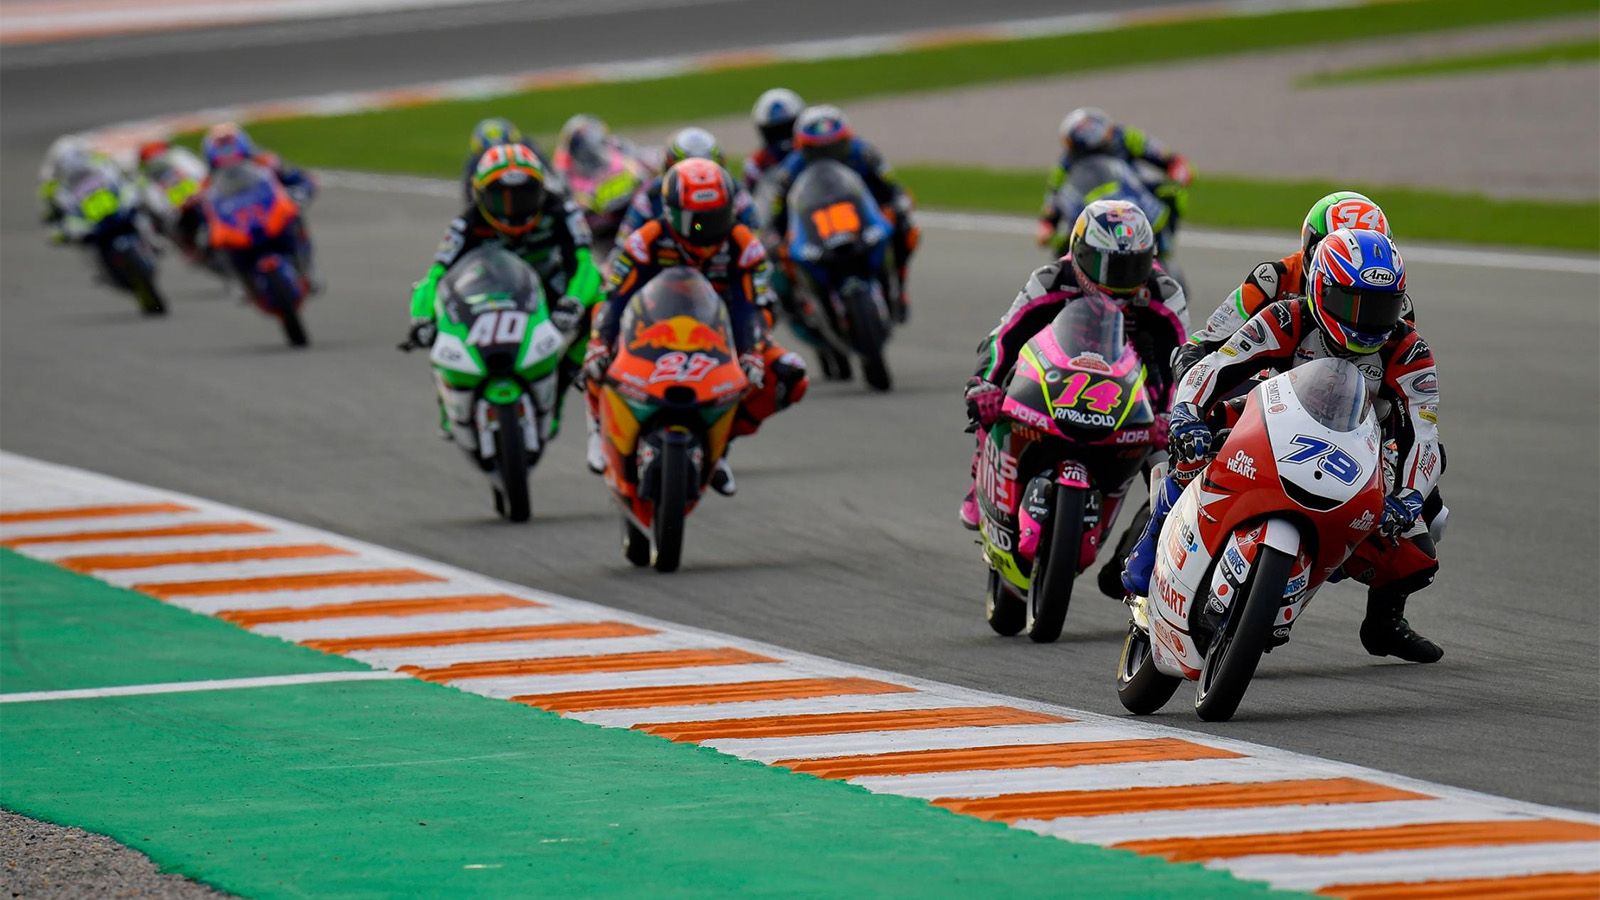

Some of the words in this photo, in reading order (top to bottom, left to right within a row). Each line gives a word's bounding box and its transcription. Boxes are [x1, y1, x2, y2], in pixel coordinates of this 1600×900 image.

[1337, 205, 1380, 230] 54
[1363, 269, 1392, 280] Arai
[649, 352, 719, 384] 27
[1363, 365, 1382, 378] Arai
[1052, 372, 1122, 414] 14
[1011, 405, 1049, 429] JOFA
[1055, 408, 1116, 427] RIVACOLD
[1116, 430, 1150, 443] JOFA
[1235, 449, 1254, 466] One
[1279, 434, 1363, 486] 79
